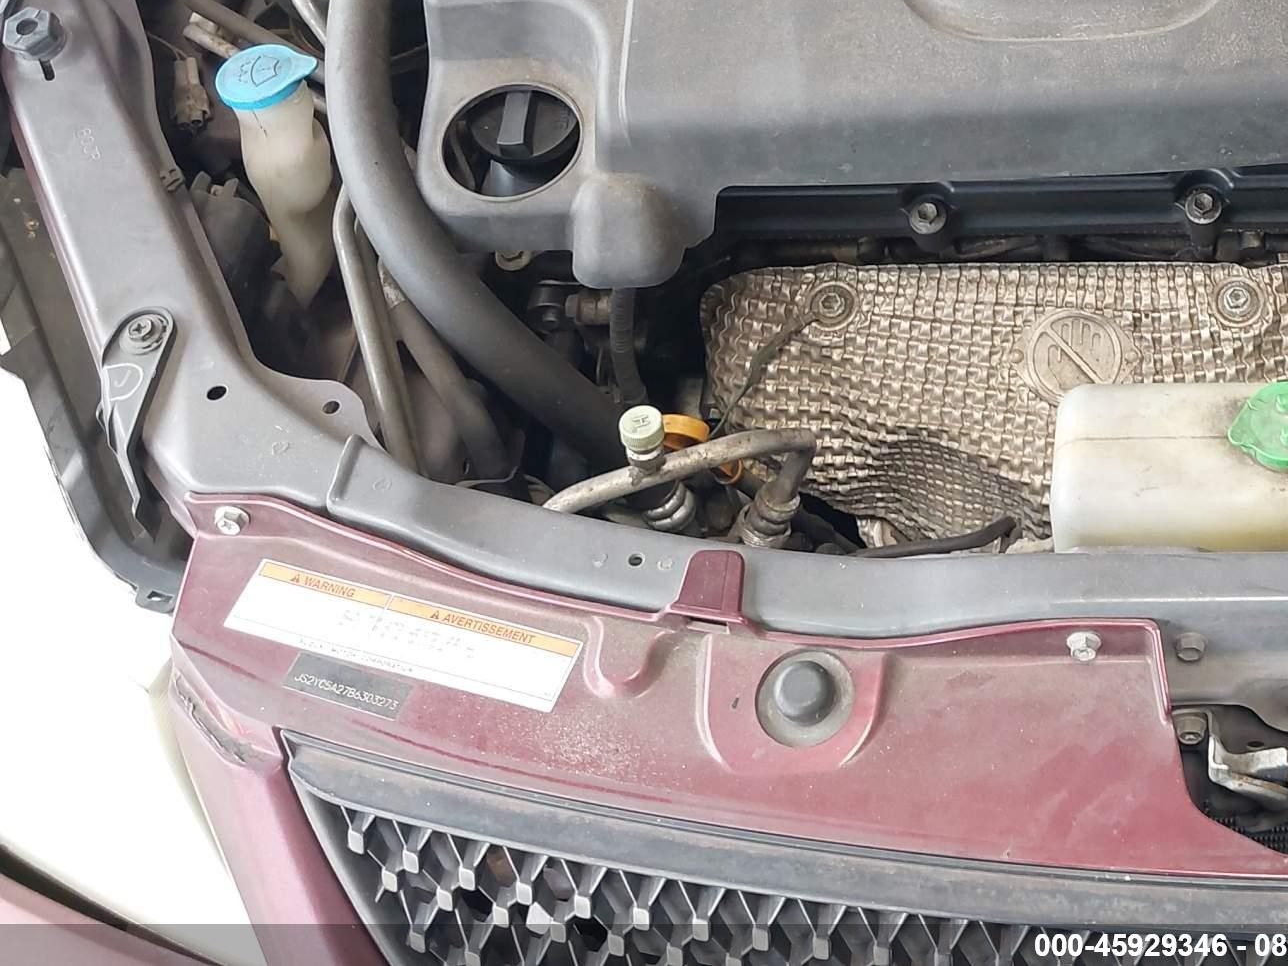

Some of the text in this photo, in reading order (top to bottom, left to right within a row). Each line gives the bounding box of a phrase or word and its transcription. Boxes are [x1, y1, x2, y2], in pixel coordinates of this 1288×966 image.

[304, 576, 356, 598] WARNING
[442, 613, 536, 644] AVERTISSEMENT
[294, 672, 400, 711] JS2YC5A27B6303273
